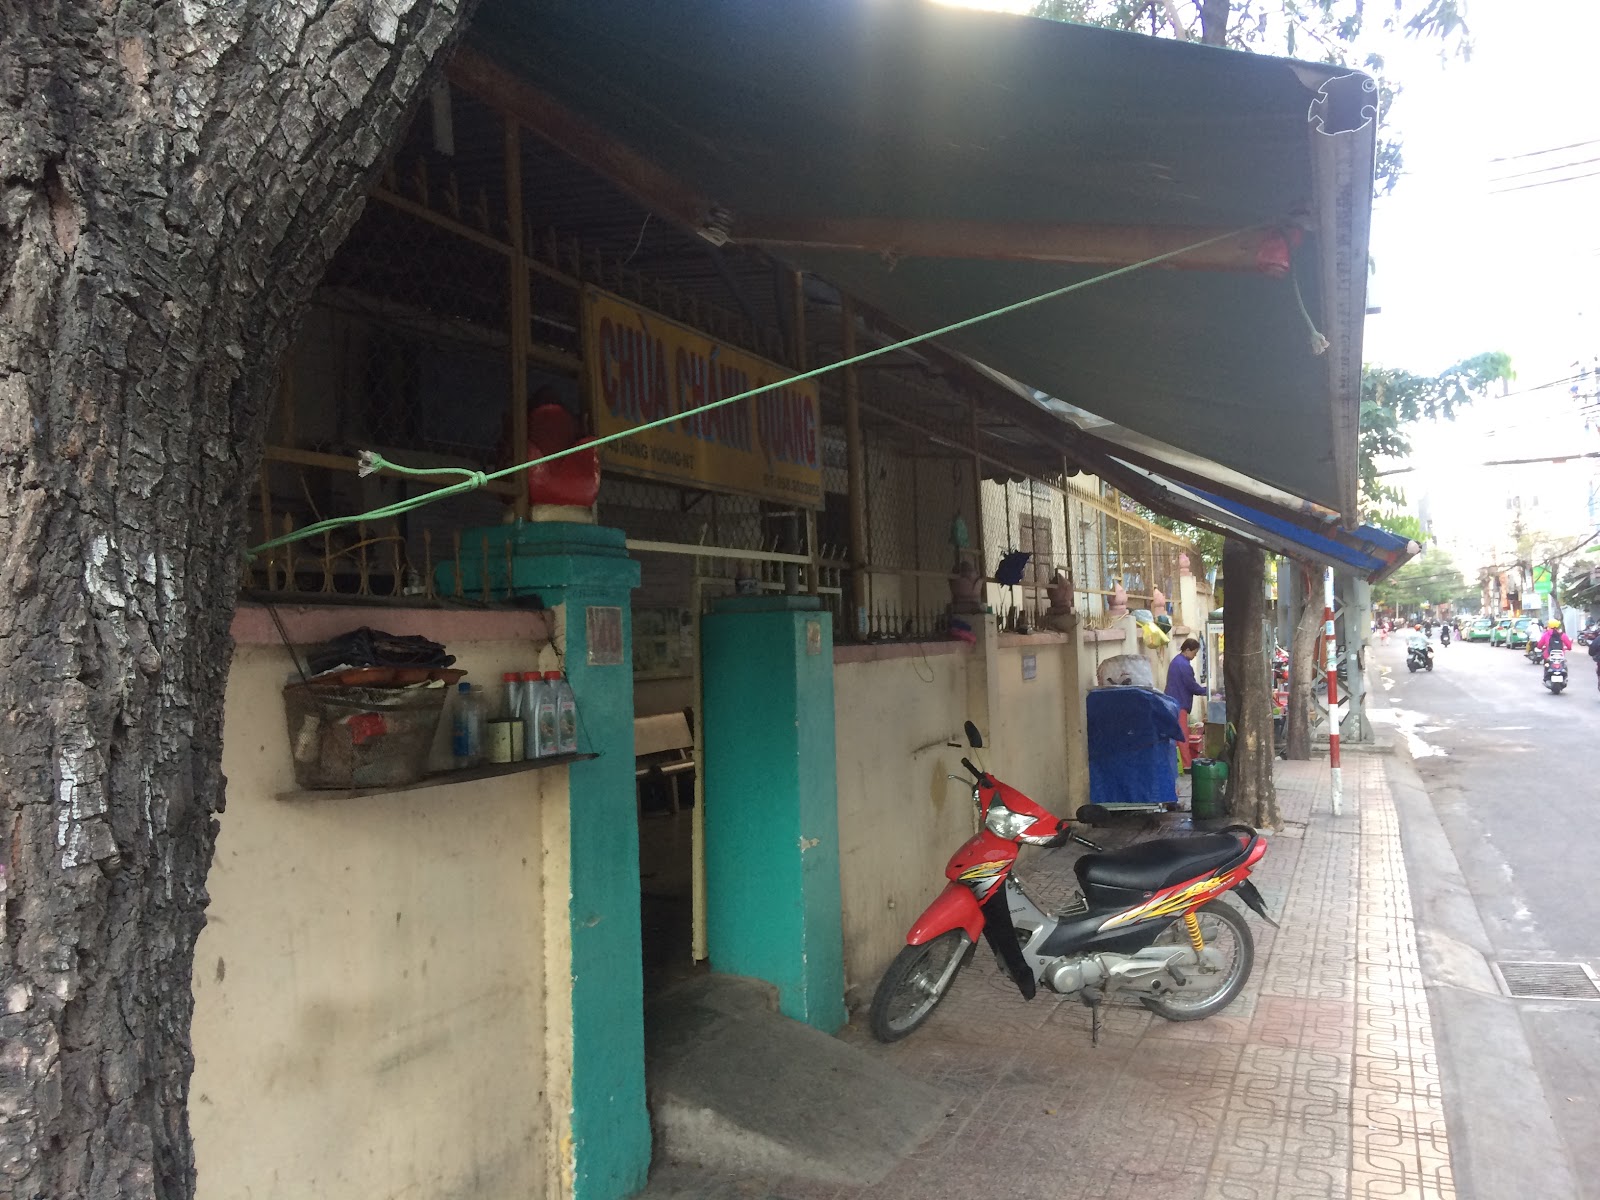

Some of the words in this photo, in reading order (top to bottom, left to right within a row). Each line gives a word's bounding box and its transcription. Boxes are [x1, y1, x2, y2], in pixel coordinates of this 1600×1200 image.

[599, 313, 674, 432] CHÙA
[676, 345, 752, 452] CHÁNH
[757, 376, 818, 473] QUANG
